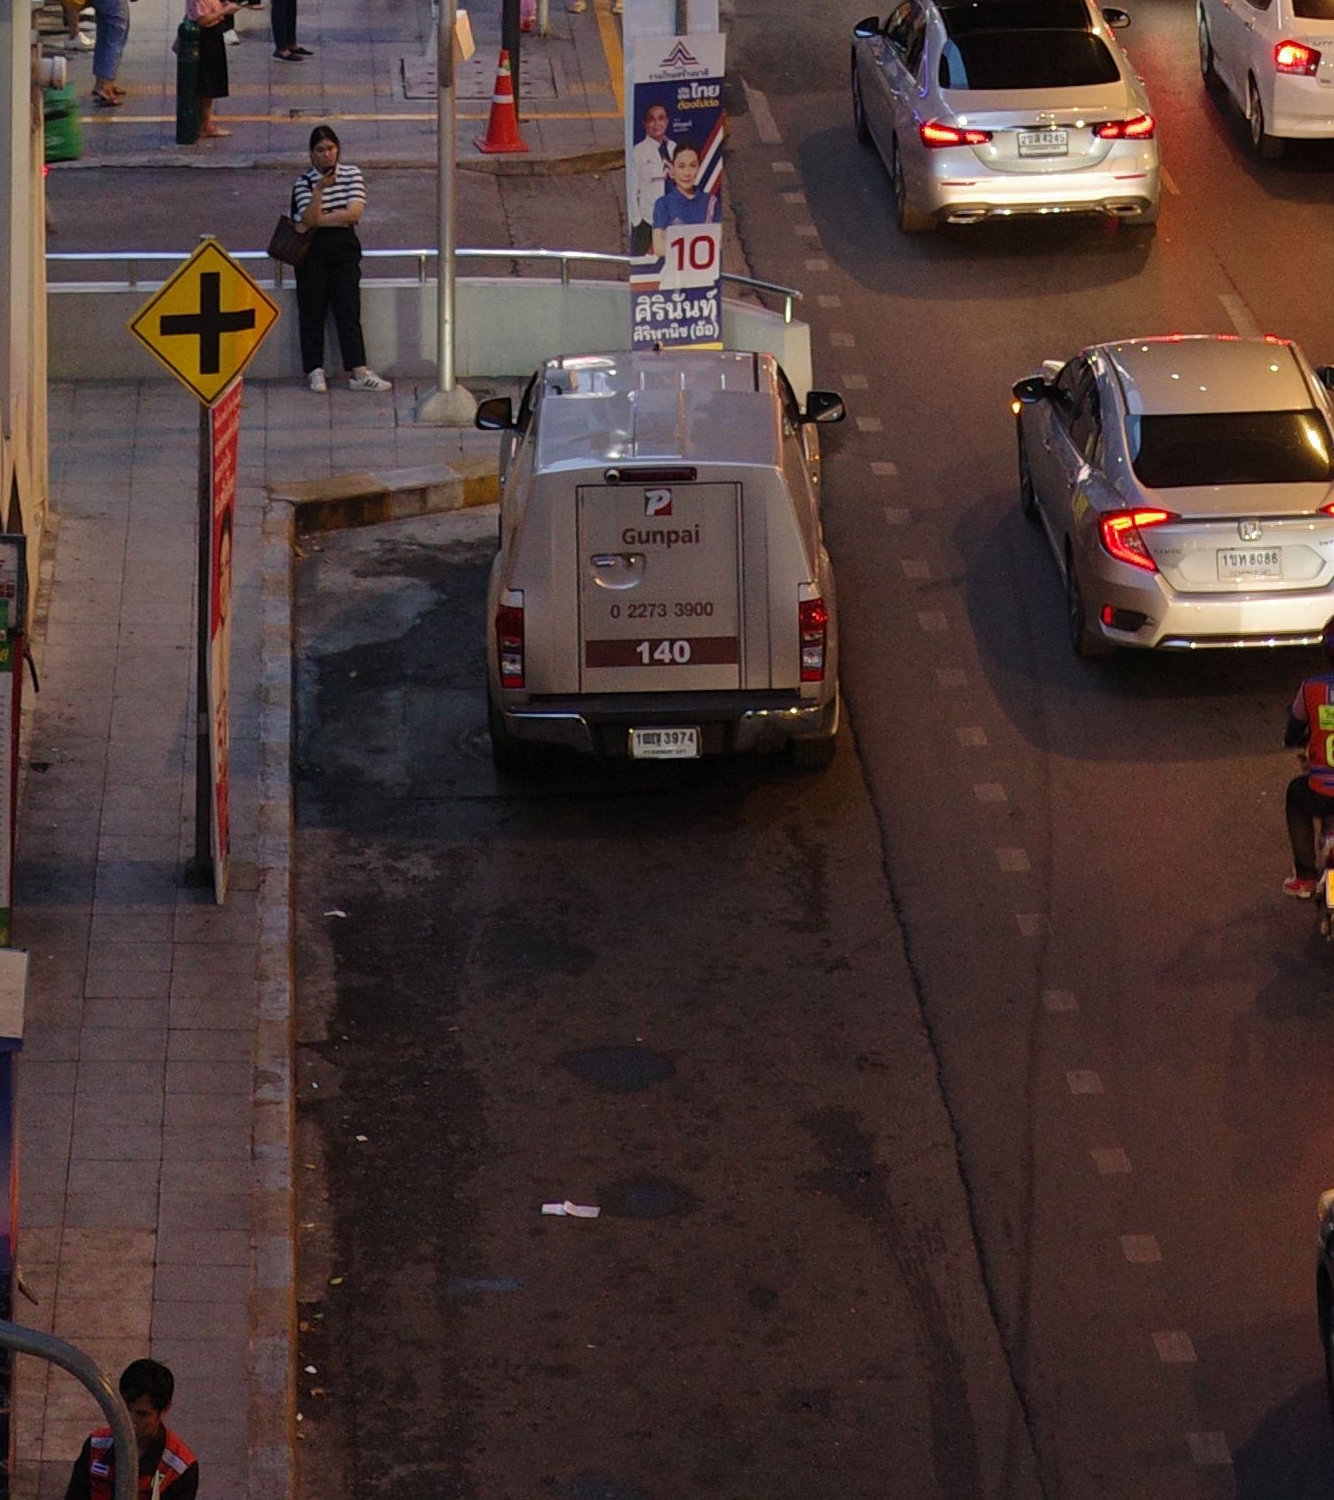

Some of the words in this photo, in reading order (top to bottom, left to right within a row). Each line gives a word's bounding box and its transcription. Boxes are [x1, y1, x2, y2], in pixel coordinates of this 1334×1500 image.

[671, 235, 714, 271] 10
[635, 288, 718, 323] ศิรินันท์
[622, 524, 699, 549] Gunpai
[611, 605, 621, 619] 0
[628, 603, 667, 618] 2273
[673, 602, 713, 617] 3900
[636, 640, 691, 664] 140
[664, 731, 694, 745] 3974
